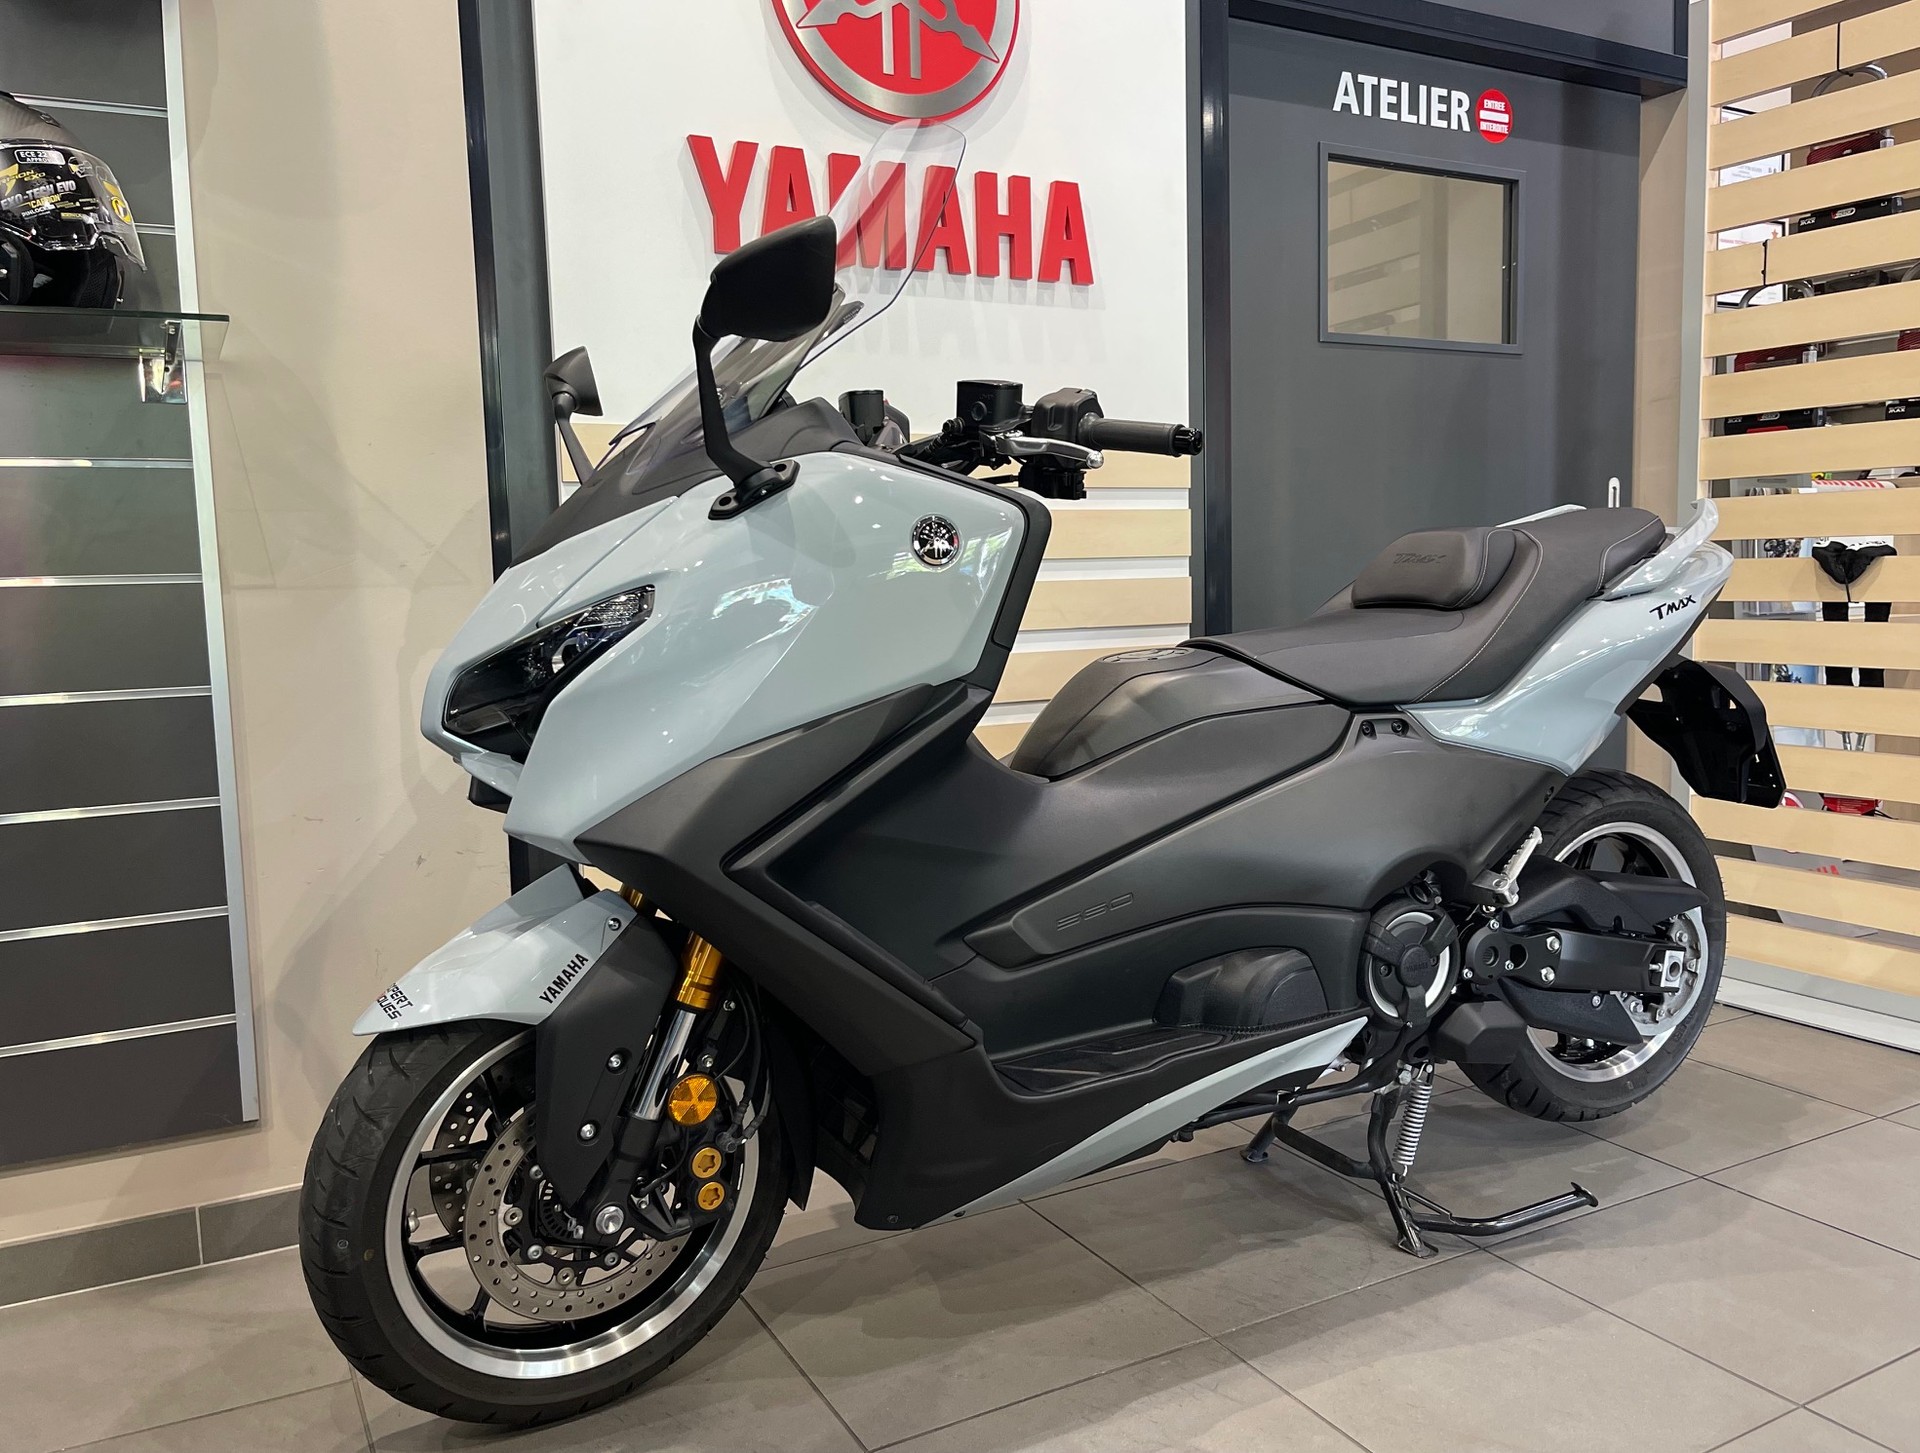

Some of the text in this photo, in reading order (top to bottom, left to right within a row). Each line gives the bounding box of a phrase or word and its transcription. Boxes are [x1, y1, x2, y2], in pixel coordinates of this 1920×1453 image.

[1332, 71, 1471, 132] ATELIER
[56, 180, 77, 193] EVO
[686, 134, 1094, 286] YAMAHA
[538, 953, 589, 1004] YAMAHA
